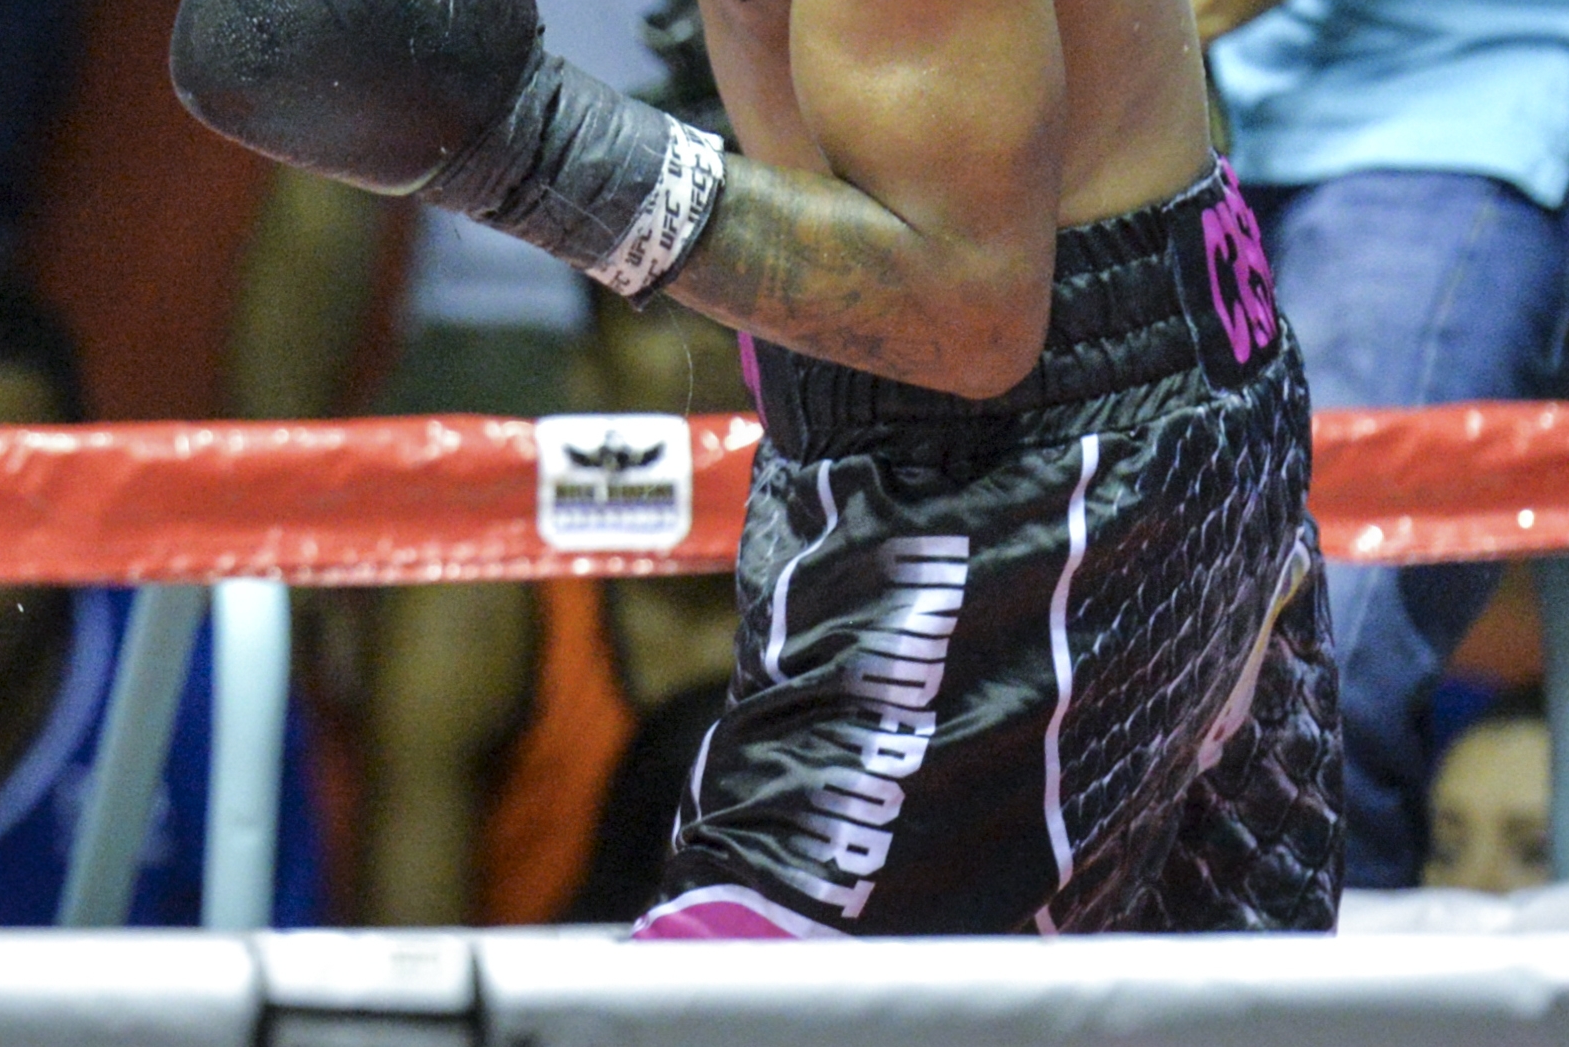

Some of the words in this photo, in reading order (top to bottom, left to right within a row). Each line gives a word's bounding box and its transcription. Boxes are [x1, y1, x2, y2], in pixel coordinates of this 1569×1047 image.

[625, 226, 653, 267] UFC
[659, 189, 681, 251] UFC
[775, 534, 971, 920] UNIDEPORT
